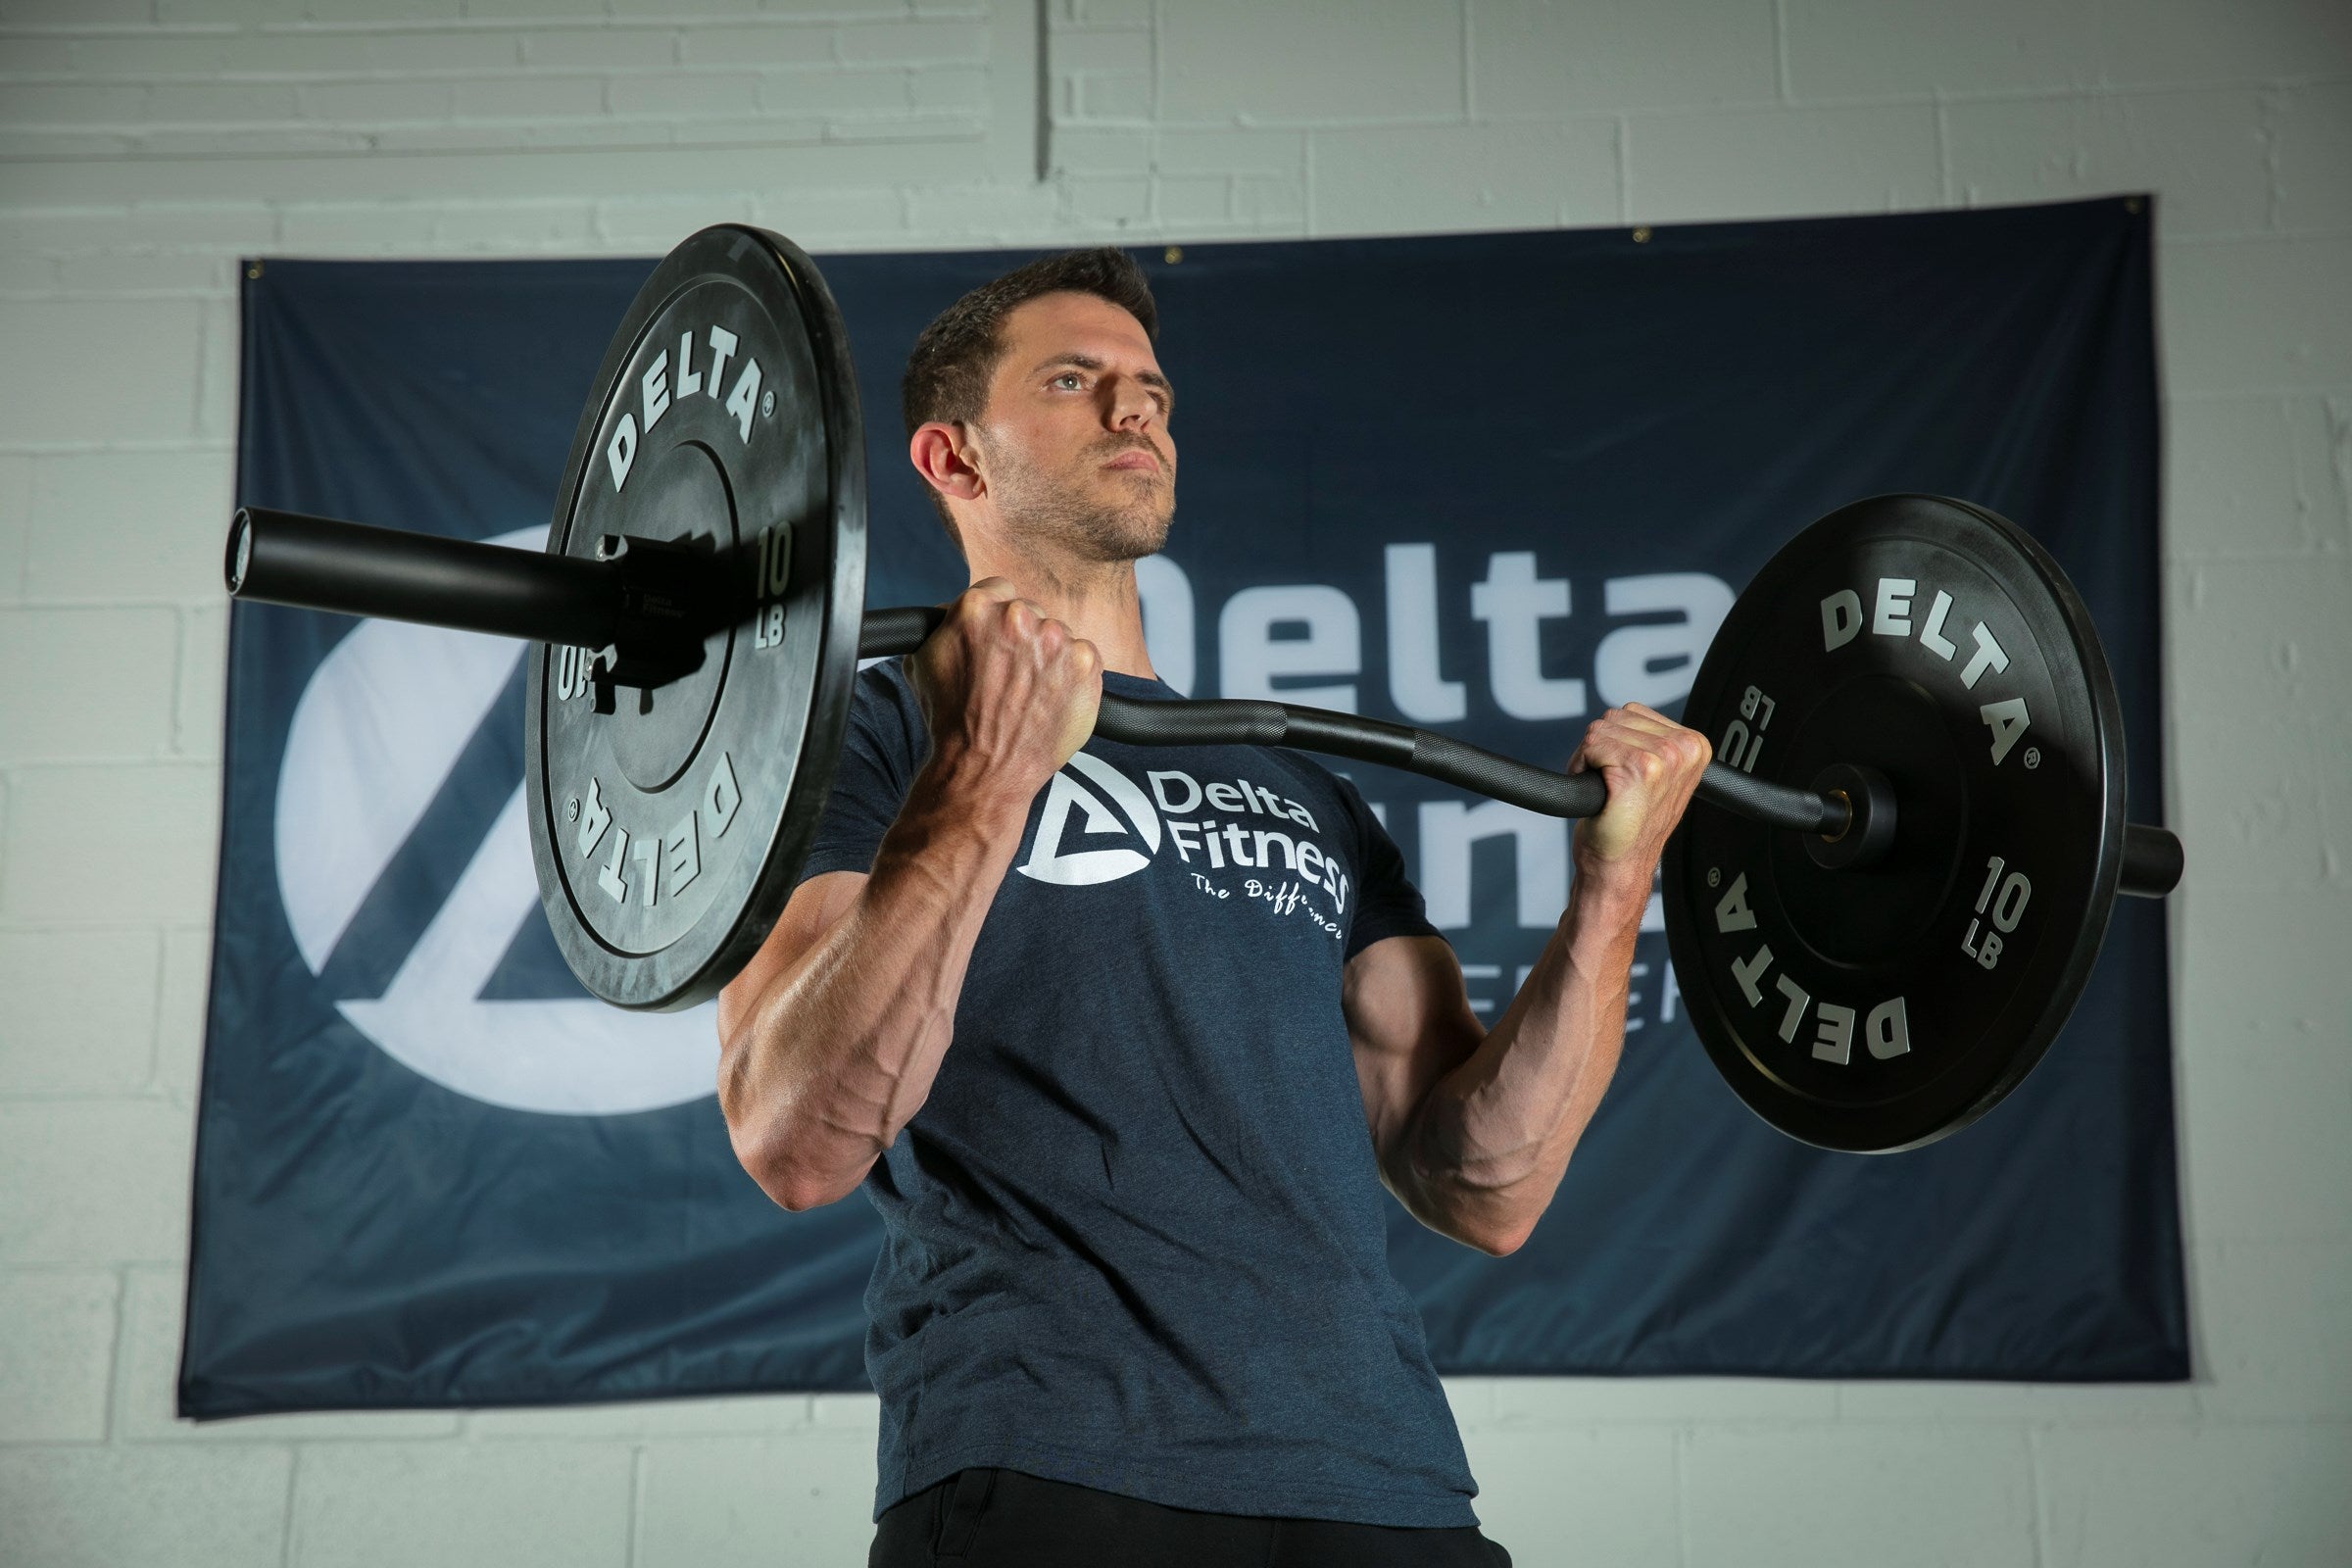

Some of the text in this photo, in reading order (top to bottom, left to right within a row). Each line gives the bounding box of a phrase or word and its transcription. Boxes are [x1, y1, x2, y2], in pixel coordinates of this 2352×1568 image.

[757, 520, 794, 599] 10
[755, 602, 787, 650] LB
[1740, 685, 1776, 731] LB
[1147, 770, 1320, 833] Delta
[1166, 819, 1349, 914] Fitness
[1191, 872, 1230, 900] The
[1974, 856, 2032, 933] 10
[1961, 918, 2004, 971] LB
